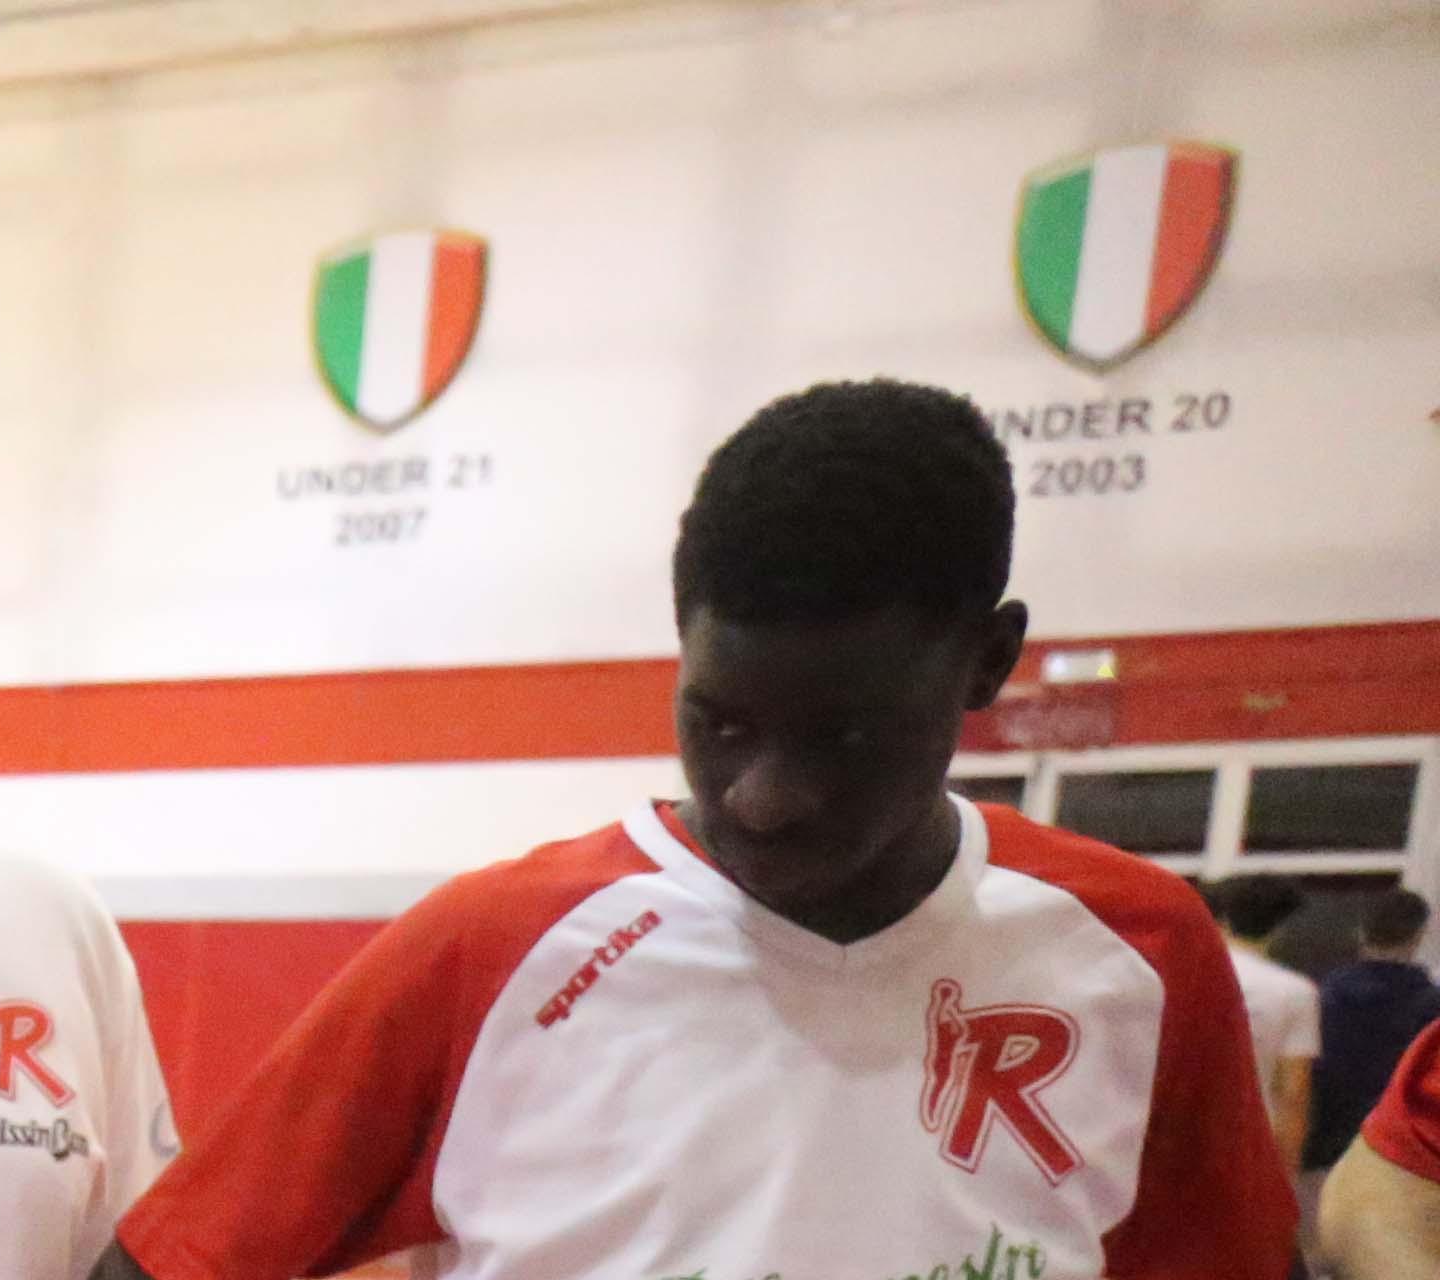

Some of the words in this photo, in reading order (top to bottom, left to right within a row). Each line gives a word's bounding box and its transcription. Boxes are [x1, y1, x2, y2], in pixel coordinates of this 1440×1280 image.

[986, 398, 1153, 439] NDER
[1171, 392, 1232, 432] 20
[276, 458, 430, 501] UNDER
[446, 453, 494, 489] 21
[1030, 453, 1146, 497] 2003
[335, 506, 428, 547] 2007
[534, 907, 663, 1030] sportika
